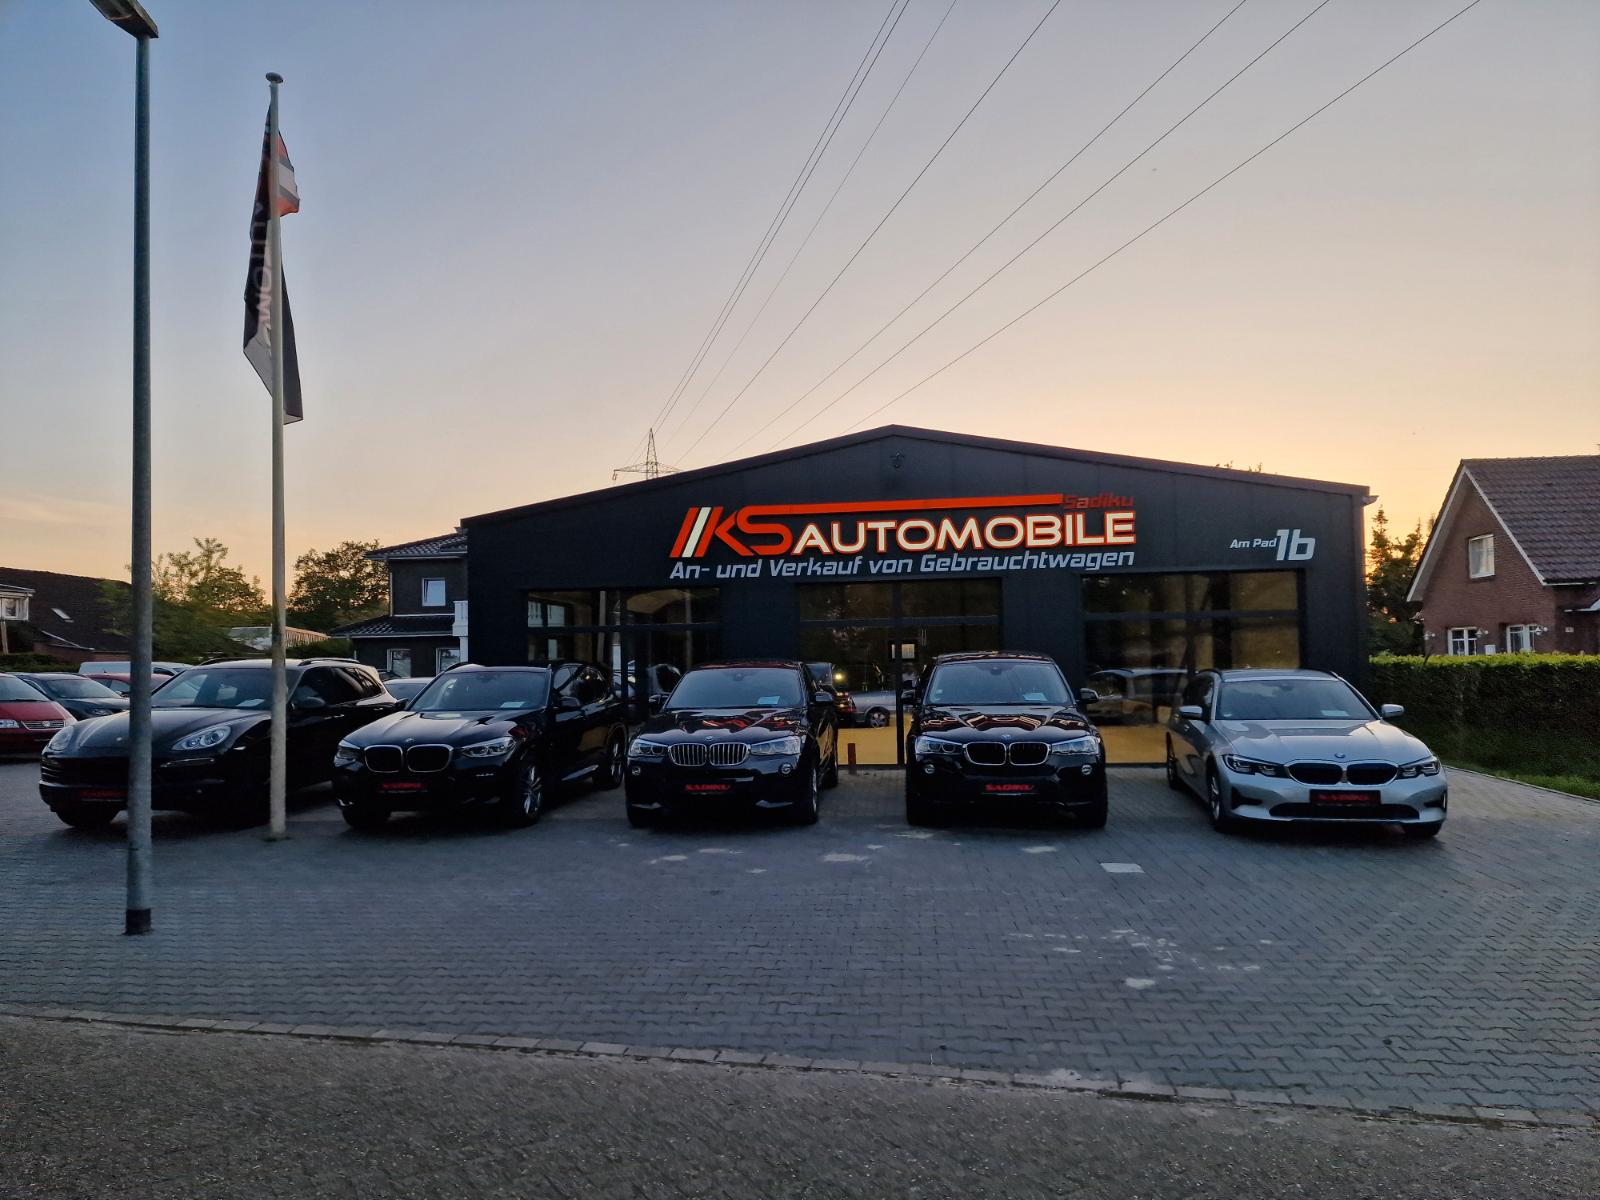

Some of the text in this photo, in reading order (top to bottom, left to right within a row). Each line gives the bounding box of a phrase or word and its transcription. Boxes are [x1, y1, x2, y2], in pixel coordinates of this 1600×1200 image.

[1063, 492, 1135, 510] Sadiku
[790, 511, 1136, 557] AUTOMOBILE
[1229, 539, 1250, 549] Am
[1252, 538, 1278, 548] Pad
[669, 550, 1135, 579] An- und Verkauf von Gebrauchtwagen
